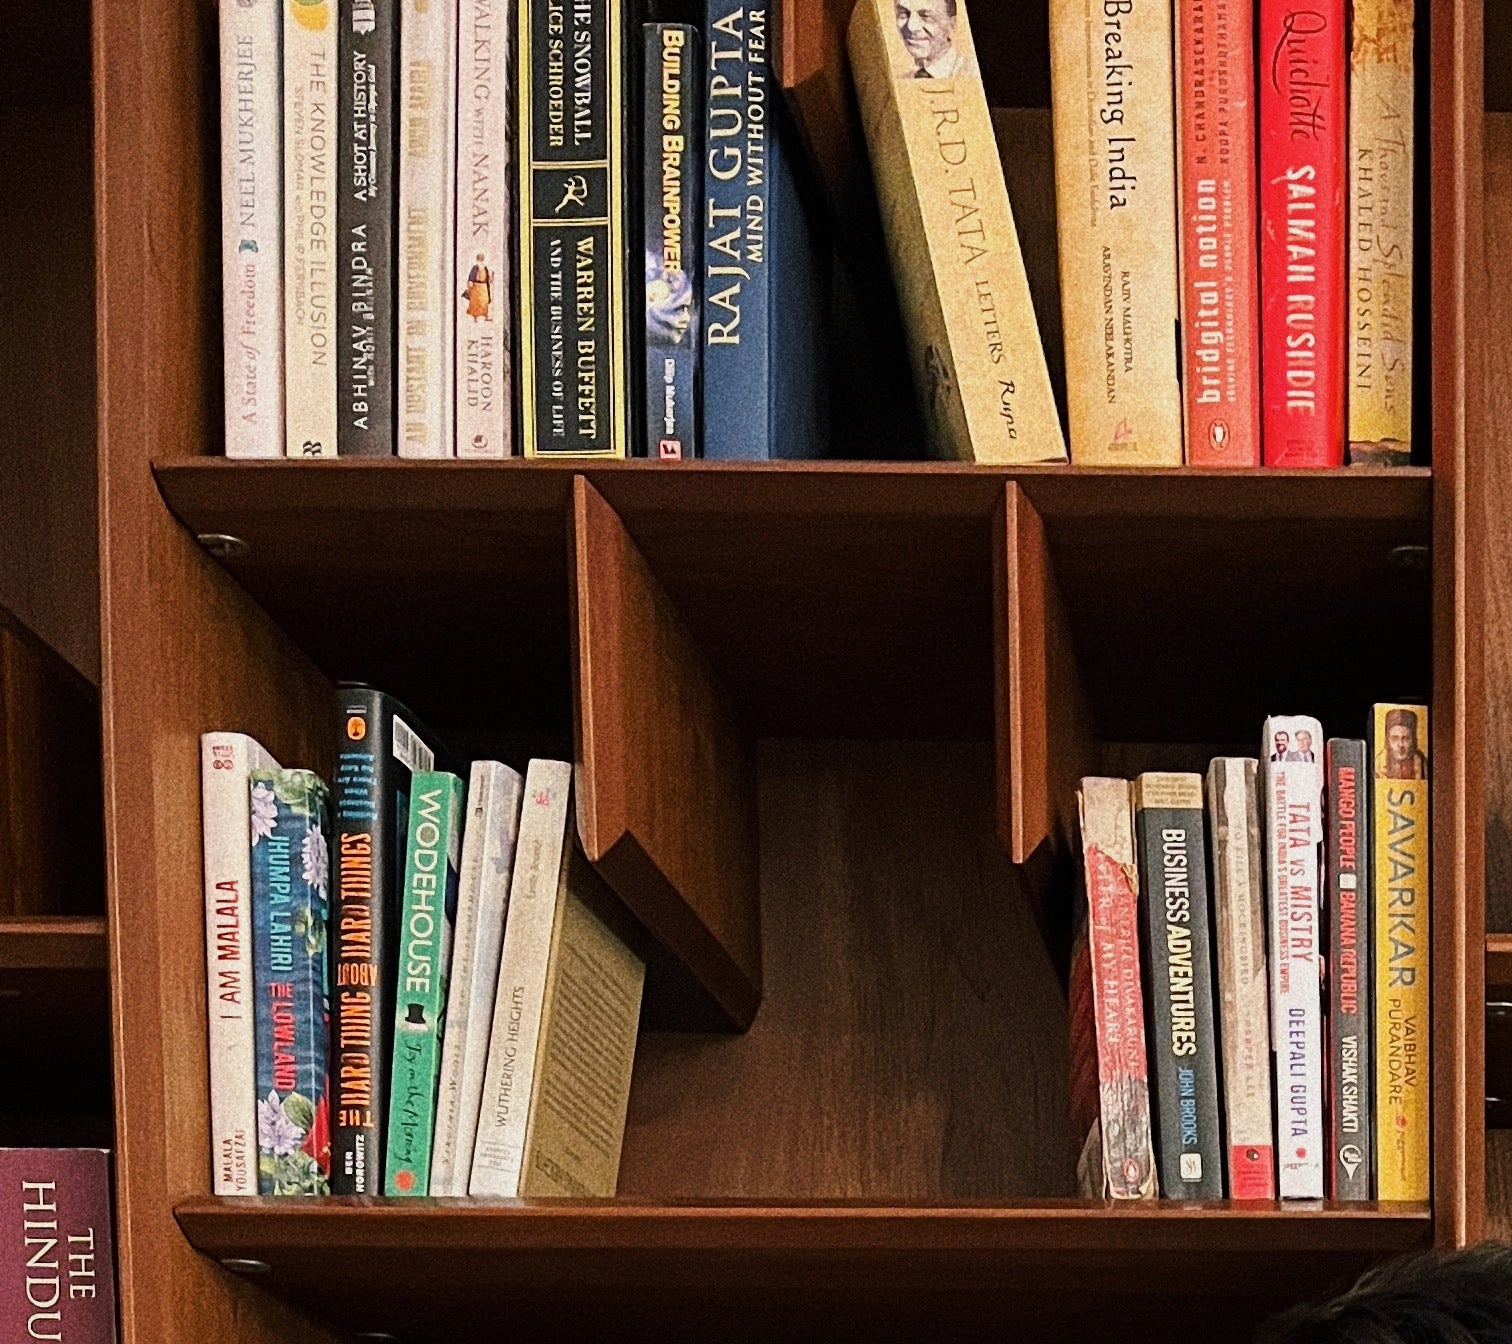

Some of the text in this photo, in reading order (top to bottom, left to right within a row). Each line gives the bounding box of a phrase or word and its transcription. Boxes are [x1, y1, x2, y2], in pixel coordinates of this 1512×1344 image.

[238, 35, 257, 227] NEEL MUKHERJEE
[573, 46, 592, 146] SNOWBALL
[662, 29, 686, 272] BUILDING BRAINPOWER
[709, 7, 751, 345] RAJAT GUPTA
[745, 8, 765, 263] MIND WITHOUT FEAR
[1100, 0, 1136, 210] Breaking India
[310, 52, 327, 366] THE KNOWLEDGE ILLUSION
[1286, 165, 1316, 415] SALMAN RUSHDIE
[1357, 149, 1377, 390] KHALED HOSSEINI
[352, 224, 368, 430] ABHINAV BINDRA
[575, 236, 596, 440] WARREN BUFFETT
[218, 880, 239, 962] MALALA
[406, 789, 442, 992] WODEHOUSE
[1161, 829, 1189, 925] BUSINESS
[1387, 789, 1416, 988] SAVARKAR
[218, 973, 241, 1004] AM
[496, 986, 525, 1128] WUTHERING HEIGHTS
[1164, 926, 1196, 1058] ADVENTURES
[1389, 998, 1403, 1106] PURANDARE
[1402, 1016, 1417, 1088] VAIBHAV
[1289, 1008, 1308, 1137] DEEPALI GUPTA
[345, 1151, 354, 1175] BEN
[355, 1134, 365, 1193] HOROWITZ
[68, 1228, 95, 1298] THE
